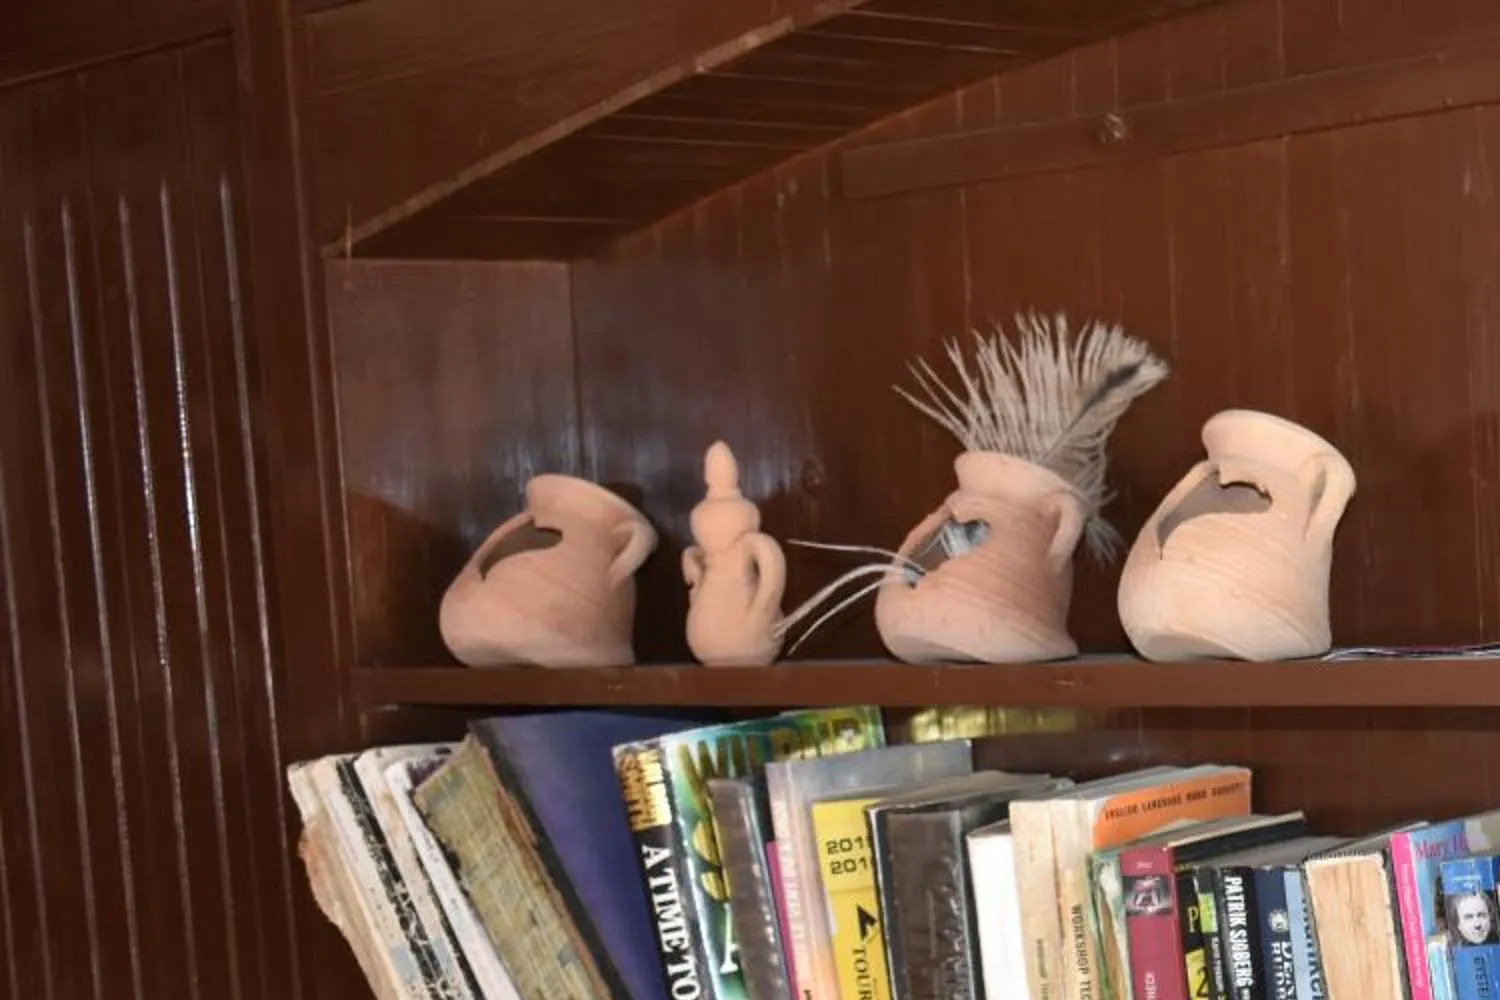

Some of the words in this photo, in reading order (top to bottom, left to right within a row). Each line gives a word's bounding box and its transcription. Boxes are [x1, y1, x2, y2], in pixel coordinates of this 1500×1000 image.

[641, 844, 672, 870] A
[825, 835, 872, 856] 201
[829, 857, 875, 876] 201
[649, 869, 690, 953] TIME
[1223, 875, 1247, 929] PATRIK
[1071, 903, 1090, 976] WORKSHOP
